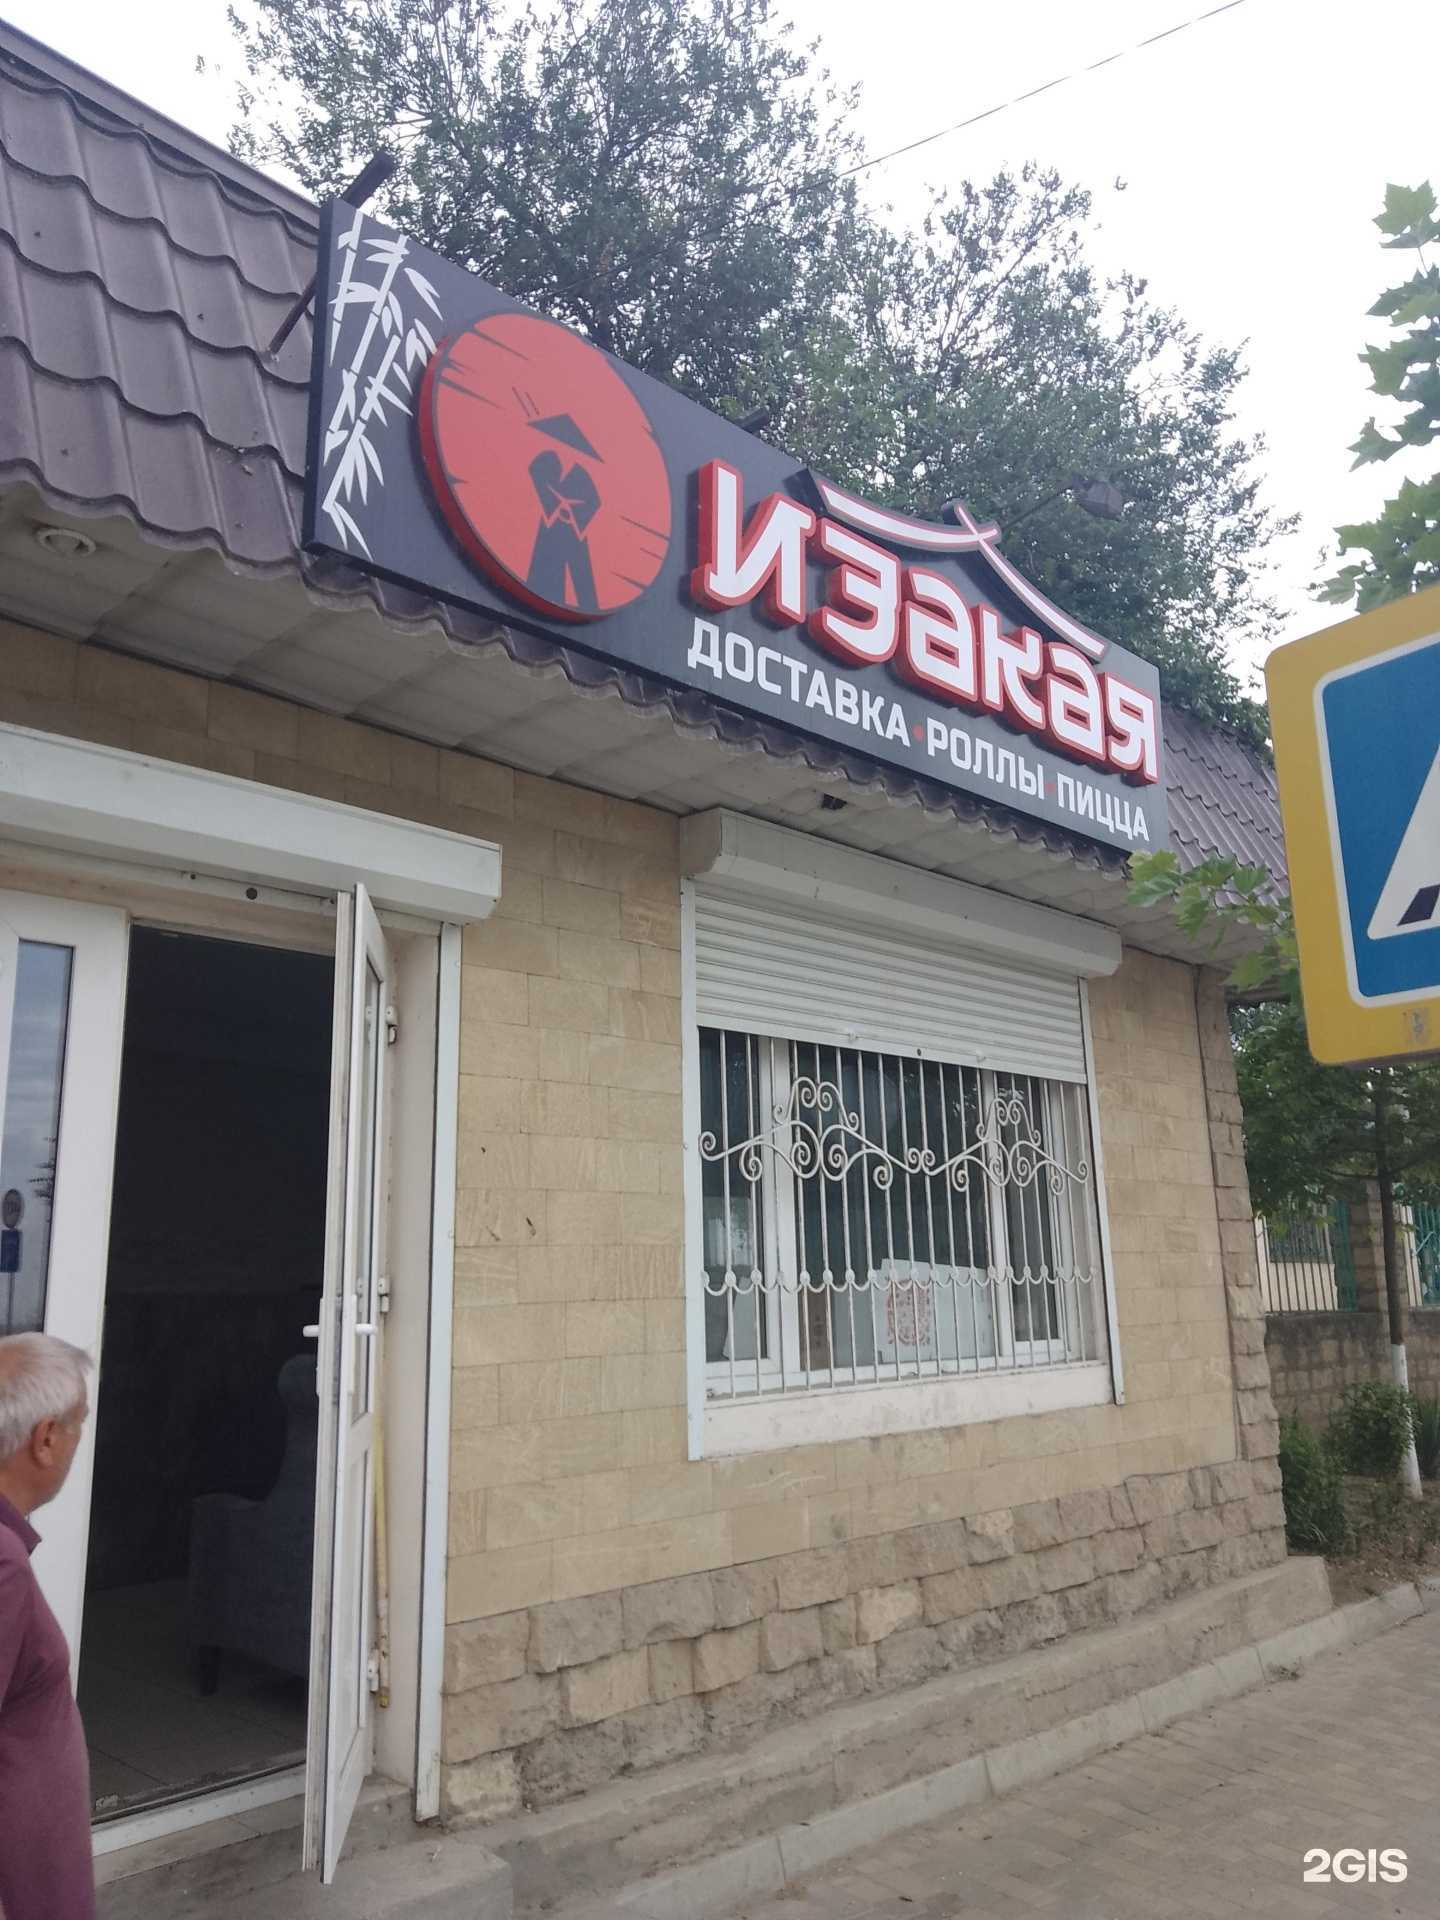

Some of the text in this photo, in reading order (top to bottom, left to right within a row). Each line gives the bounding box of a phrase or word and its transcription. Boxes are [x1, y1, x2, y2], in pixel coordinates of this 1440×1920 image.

[687, 616, 1149, 841] ДОСТАВКА РОЛЛЫ ПИЦЦА
